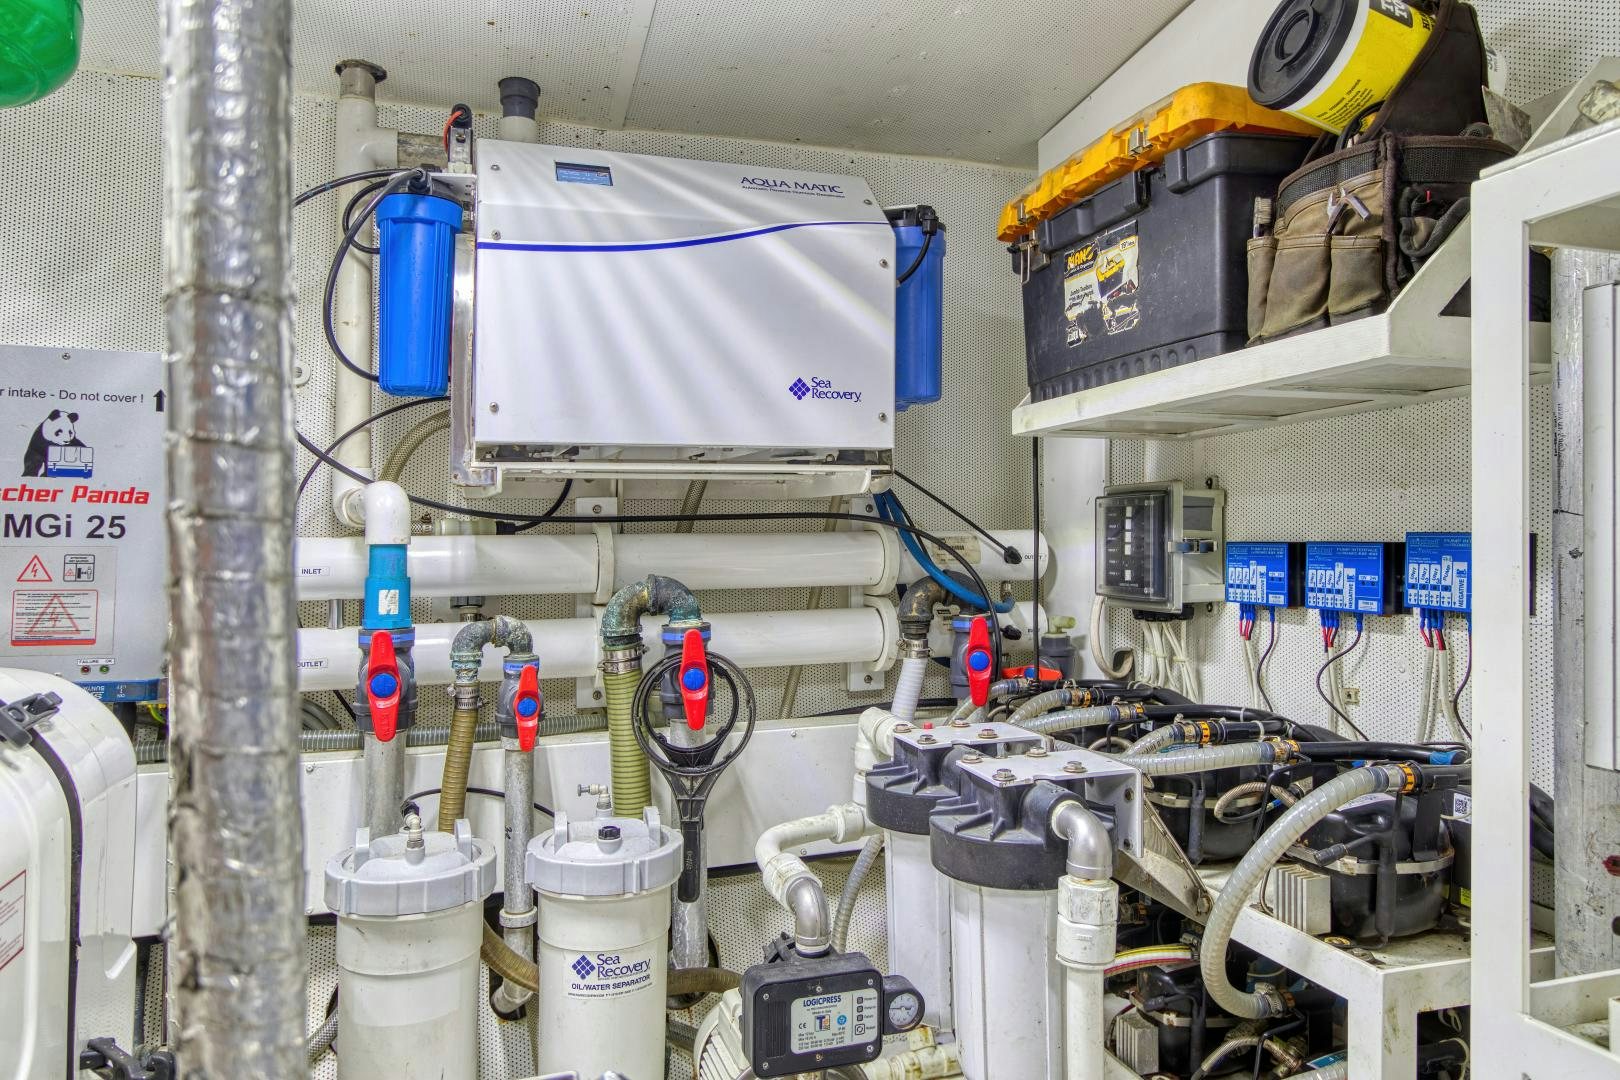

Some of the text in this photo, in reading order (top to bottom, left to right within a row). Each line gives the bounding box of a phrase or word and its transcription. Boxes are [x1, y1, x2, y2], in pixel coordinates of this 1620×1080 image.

[740, 176, 844, 194] AQUA MATIC
[811, 376, 832, 389] Sea
[8, 388, 47, 399] intake
[59, 389, 77, 401] Do
[80, 391, 99, 402] not
[103, 393, 137, 403] cover
[811, 387, 862, 403] Recovery
[0, 484, 150, 505] cher Panda
[85, 514, 127, 540] 25
[1458, 578, 1466, 608] NEGATIVE
[597, 953, 621, 966] Sea
[597, 958, 651, 978] Recovery
[571, 983, 611, 991] OIL/WATER
[612, 973, 651, 990] SEPARATOR
[803, 994, 842, 1007] LOGICPRESS
